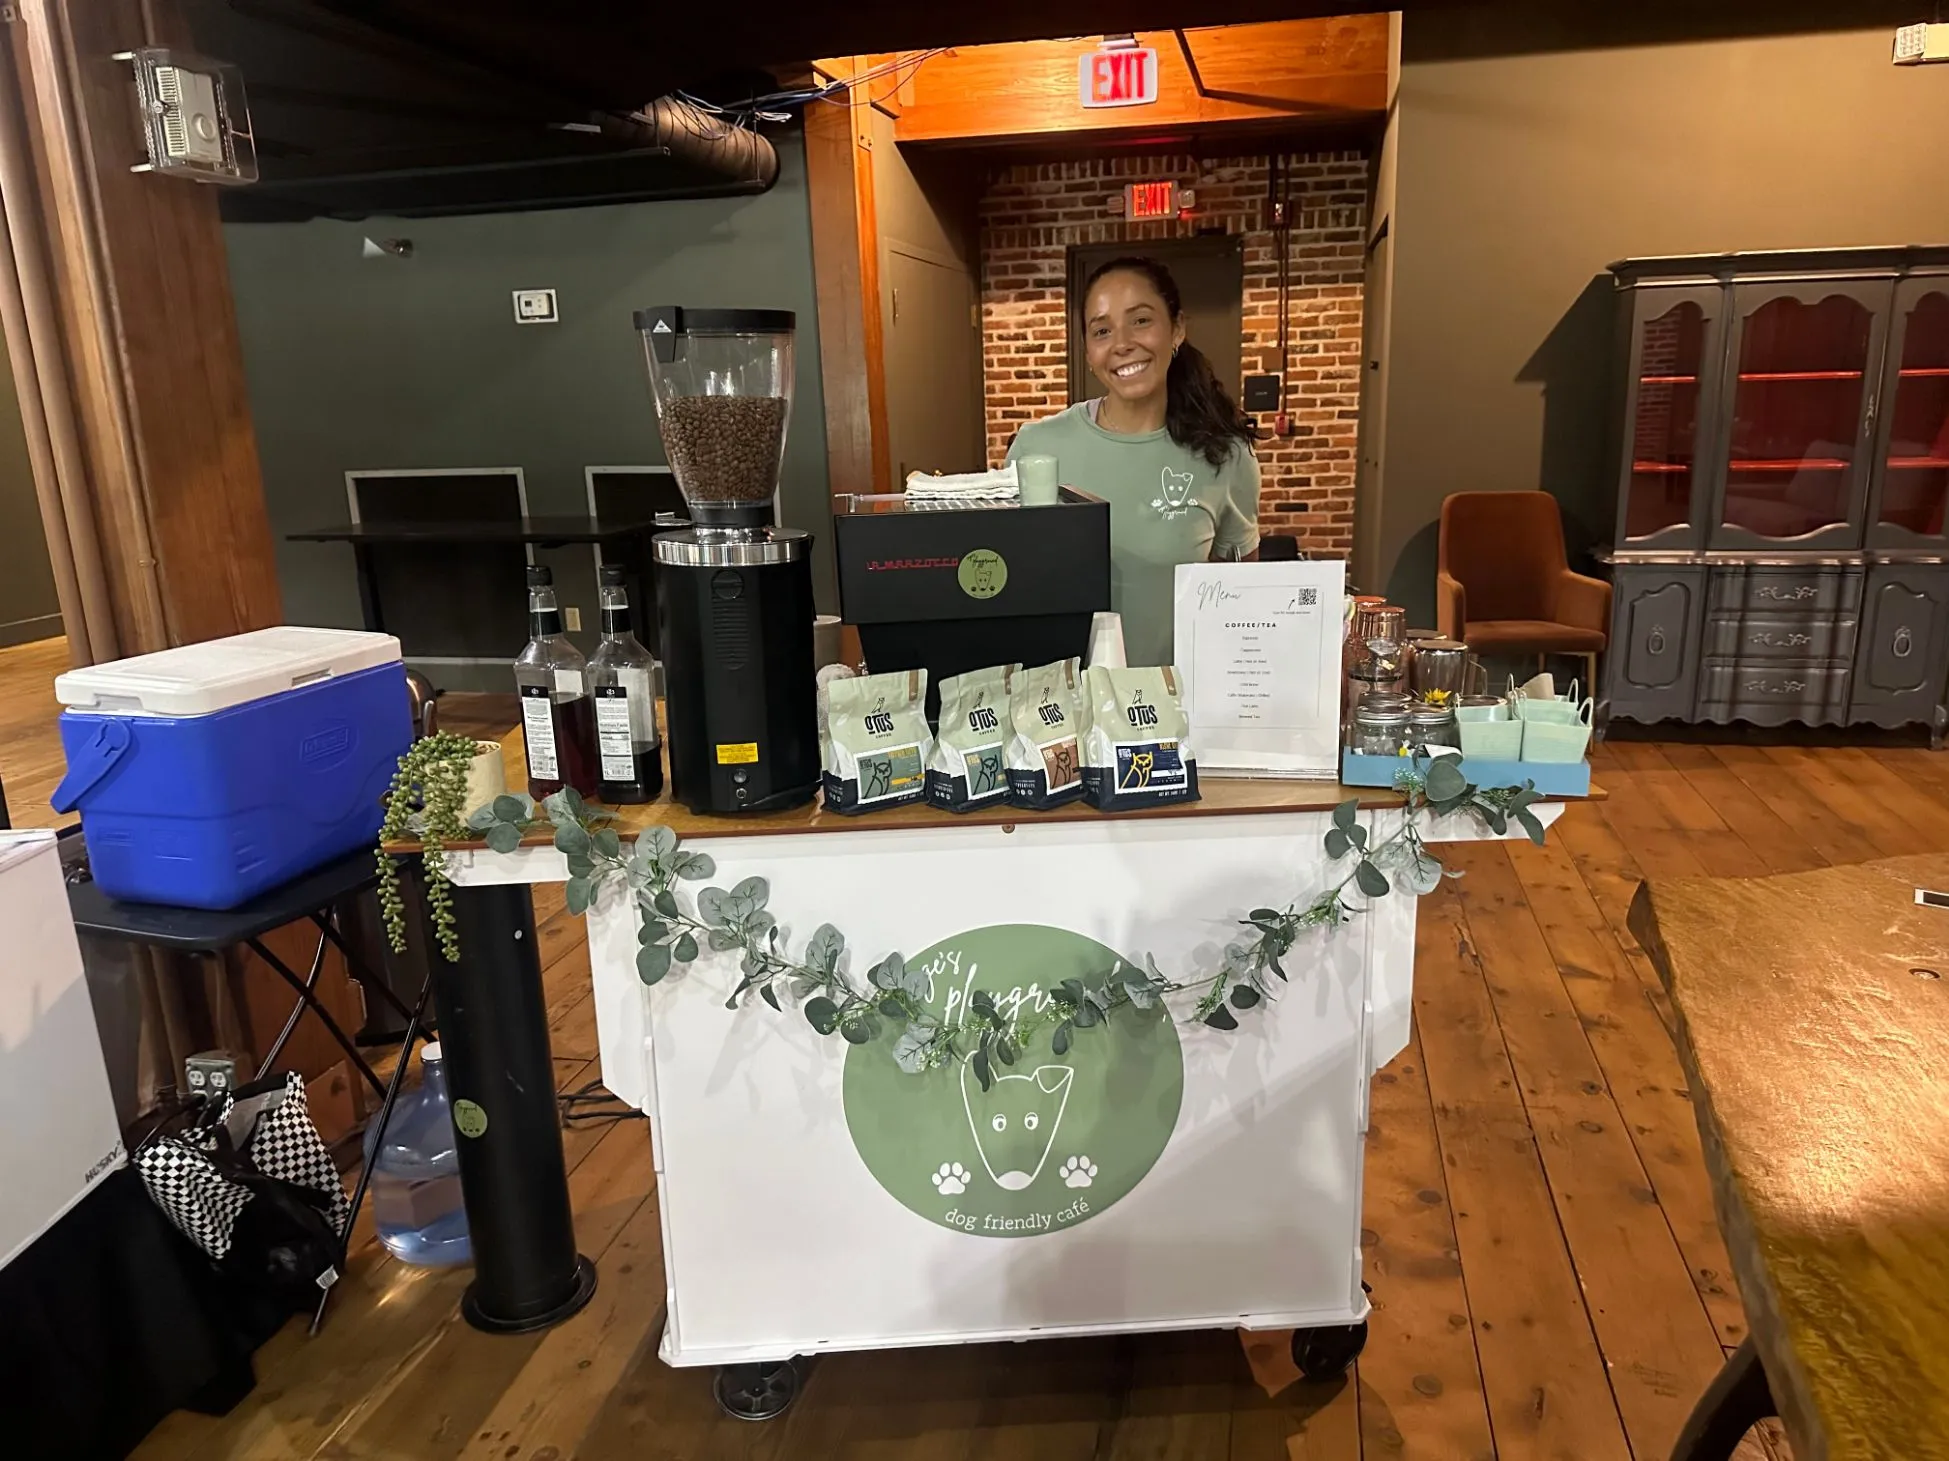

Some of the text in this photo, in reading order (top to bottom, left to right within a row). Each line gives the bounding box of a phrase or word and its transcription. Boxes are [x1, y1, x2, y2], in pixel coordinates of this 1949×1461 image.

[1091, 51, 1148, 103] EXIT
[1132, 181, 1173, 217] EXIT
[1197, 580, 1242, 611] Menu
[865, 712, 894, 735] OTUS
[968, 707, 998, 732] OTUS
[1038, 703, 1065, 726] OTUS
[1127, 705, 1158, 727] OTUS
[85, 1146, 118, 1184] HUSKY
[944, 1196, 1090, 1231] dog friendly café
